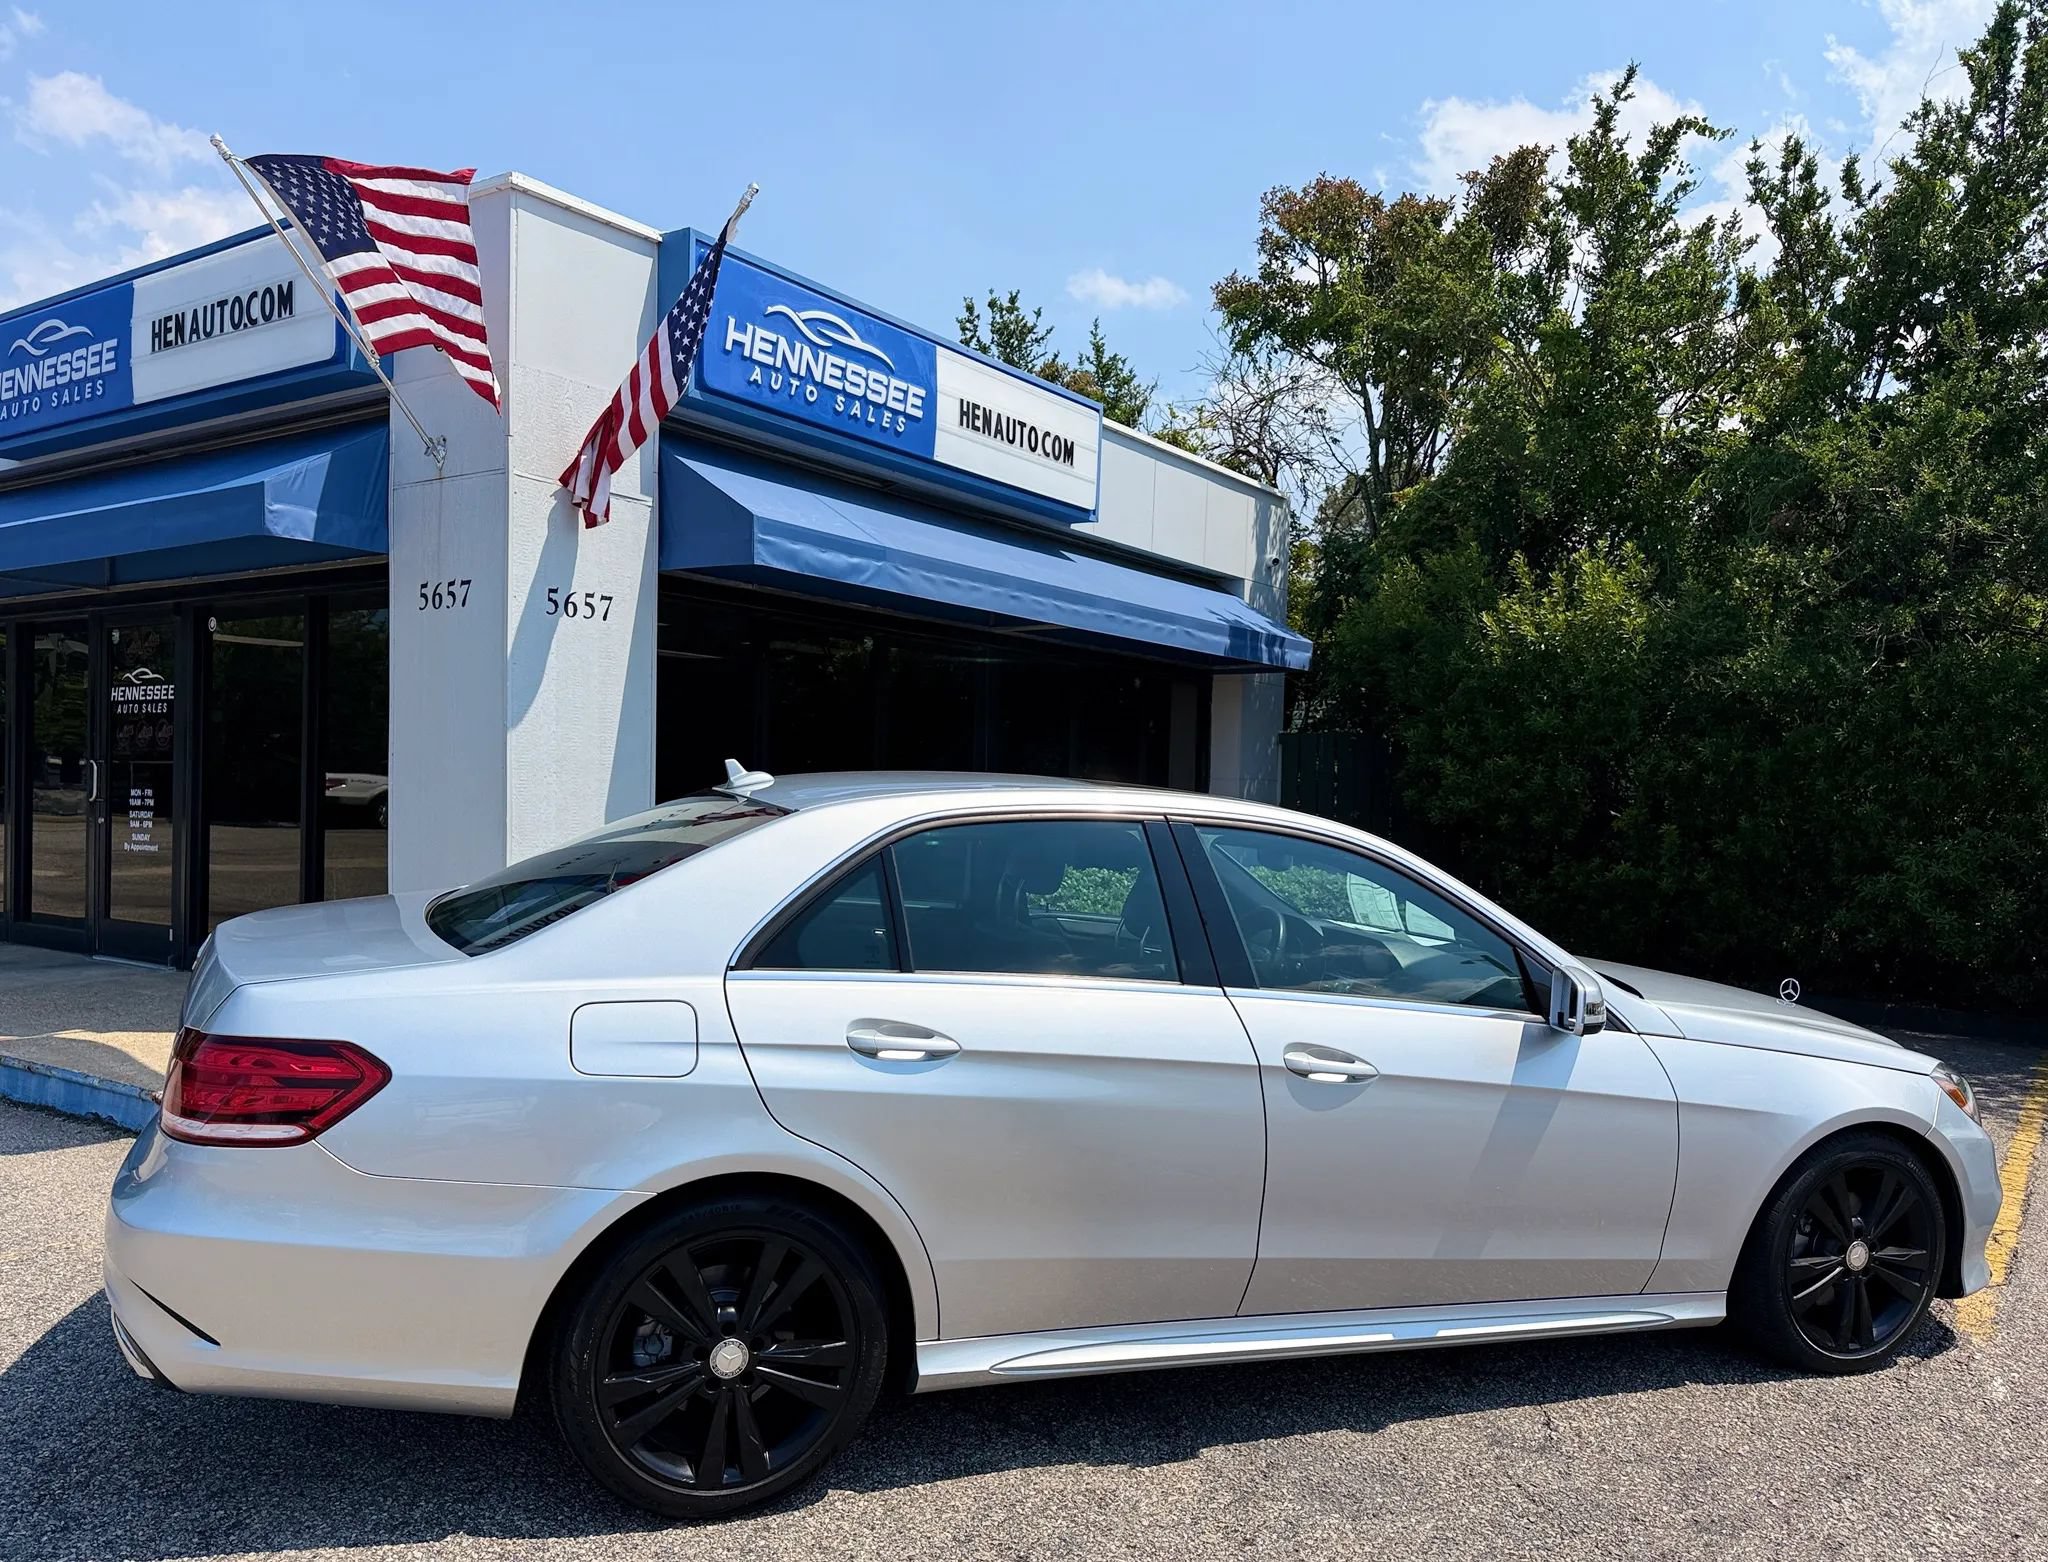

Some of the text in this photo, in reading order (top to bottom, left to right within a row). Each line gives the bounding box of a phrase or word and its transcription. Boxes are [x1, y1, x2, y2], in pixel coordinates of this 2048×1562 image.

[151, 280, 295, 353] HENAUTO.COM
[0, 338, 117, 401] ENNESSEE
[724, 315, 927, 419] HENNESSEE
[0, 379, 103, 419] AUTO SALES
[750, 365, 906, 433] AUTO SALES
[418, 579, 472, 611] 5657
[545, 587, 614, 622] 5657
[111, 684, 175, 702] HENNESSEE
[117, 702, 168, 714] AUTO SALES
[124, 842, 158, 852] By Appointment
[132, 833, 150, 841] SUNDAY
